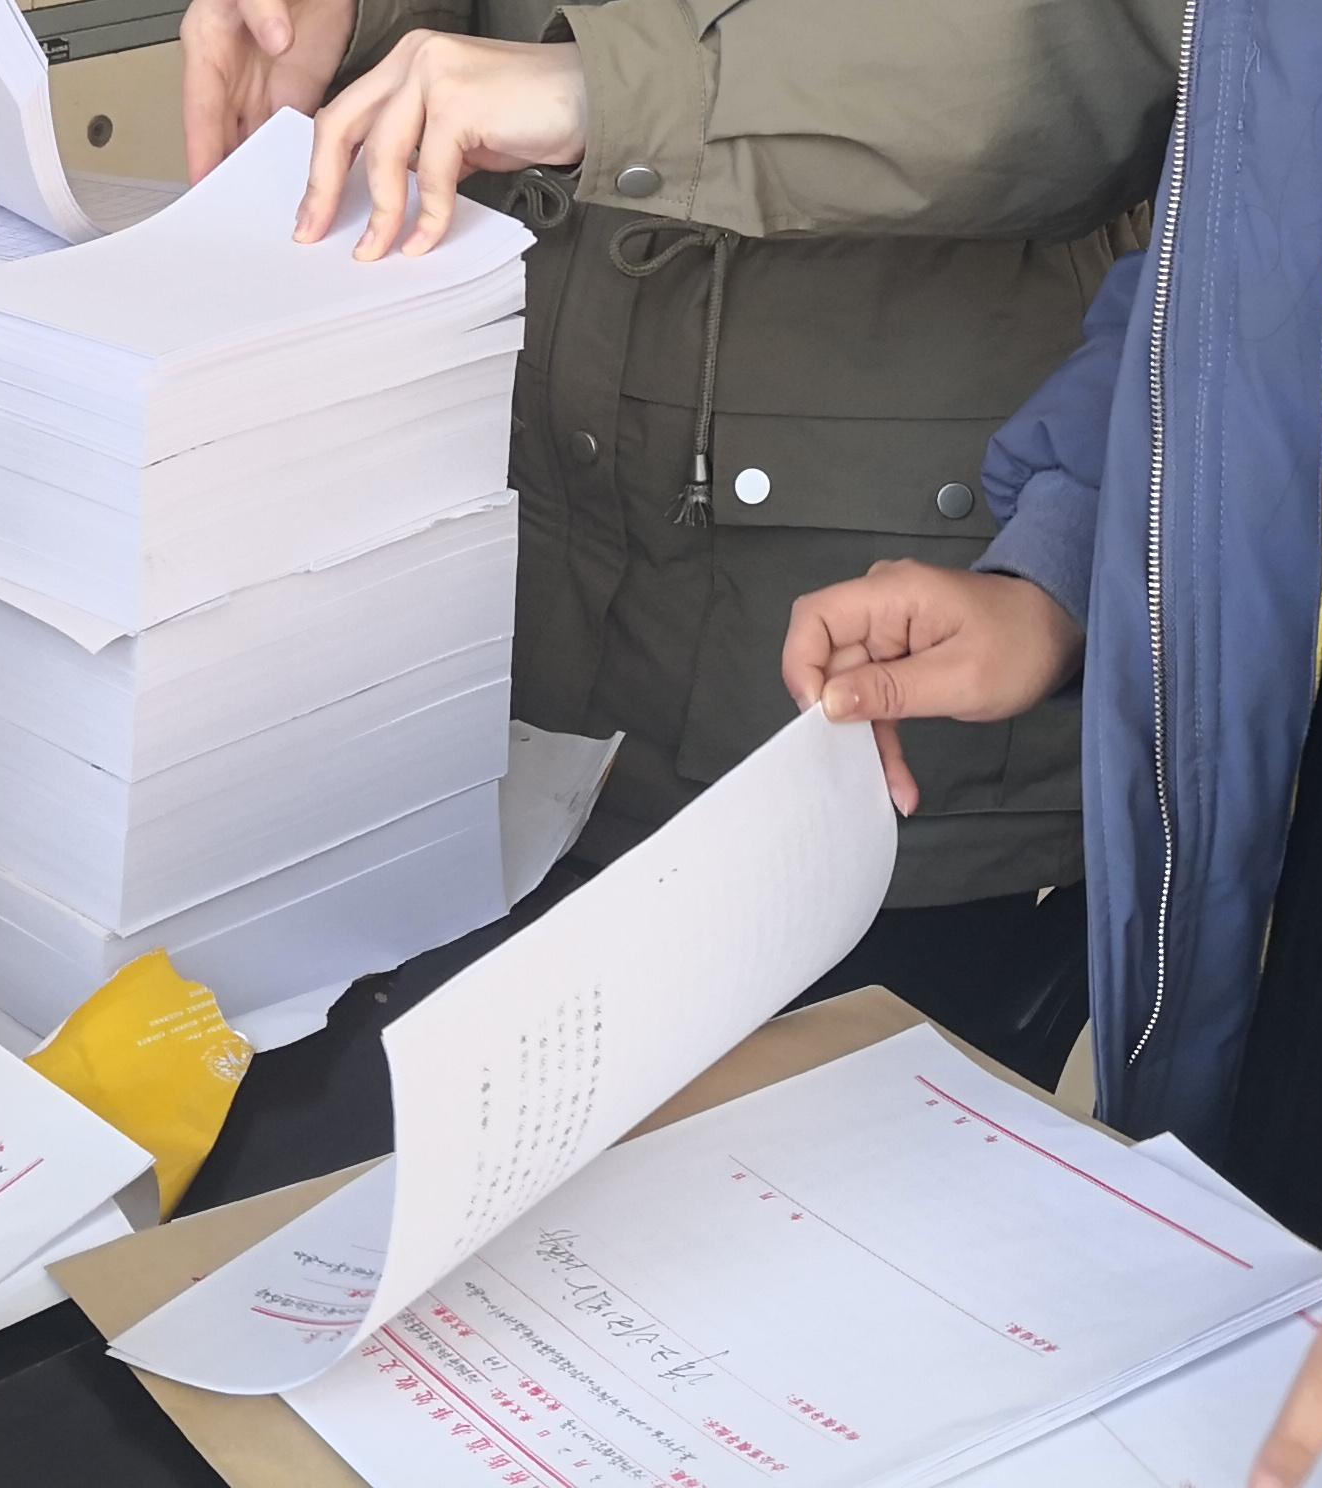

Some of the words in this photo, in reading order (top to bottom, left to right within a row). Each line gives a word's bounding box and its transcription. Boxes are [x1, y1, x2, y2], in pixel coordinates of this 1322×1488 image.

[361, 1343, 541, 1488] 桥街道办事处收文卡
